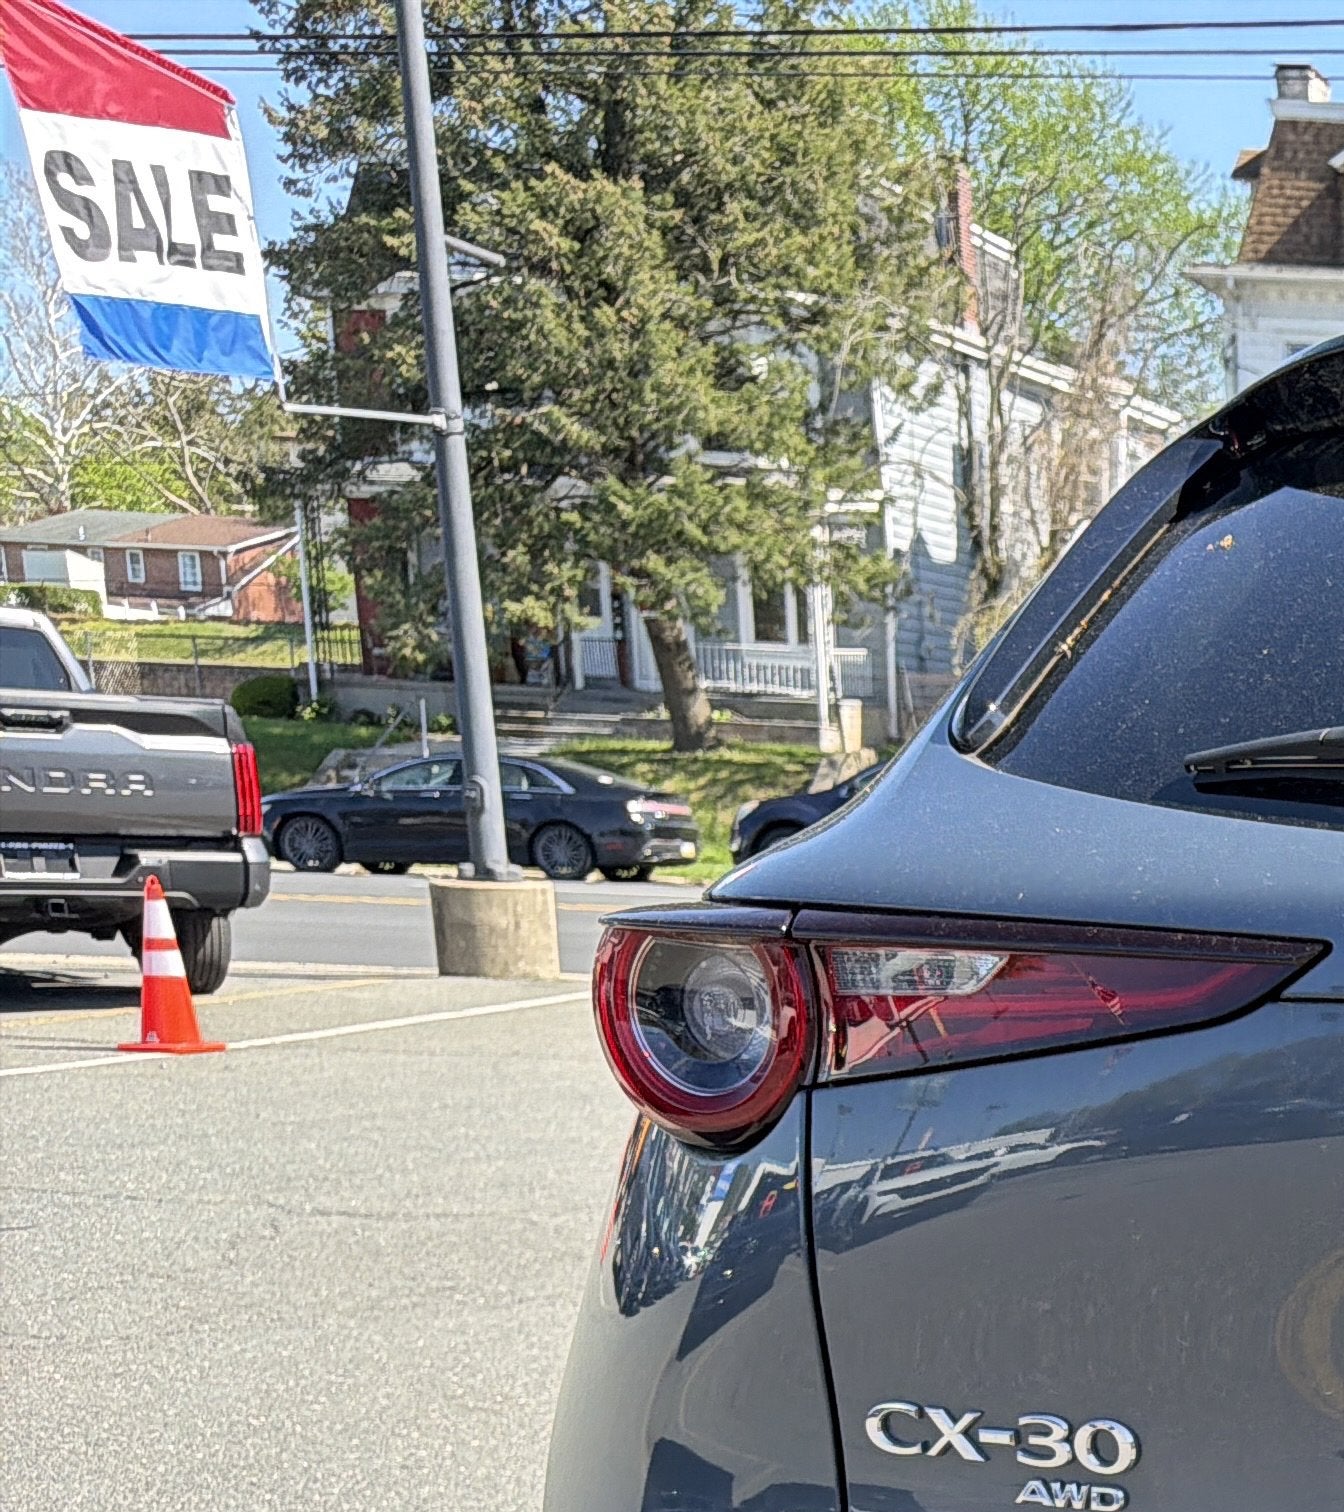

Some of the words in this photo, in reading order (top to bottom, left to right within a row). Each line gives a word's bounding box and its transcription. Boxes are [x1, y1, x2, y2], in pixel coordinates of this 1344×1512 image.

[43, 149, 245, 275] SALE
[864, 1401, 1140, 1476] CX-30
[1014, 1479, 1128, 1512] AWD
